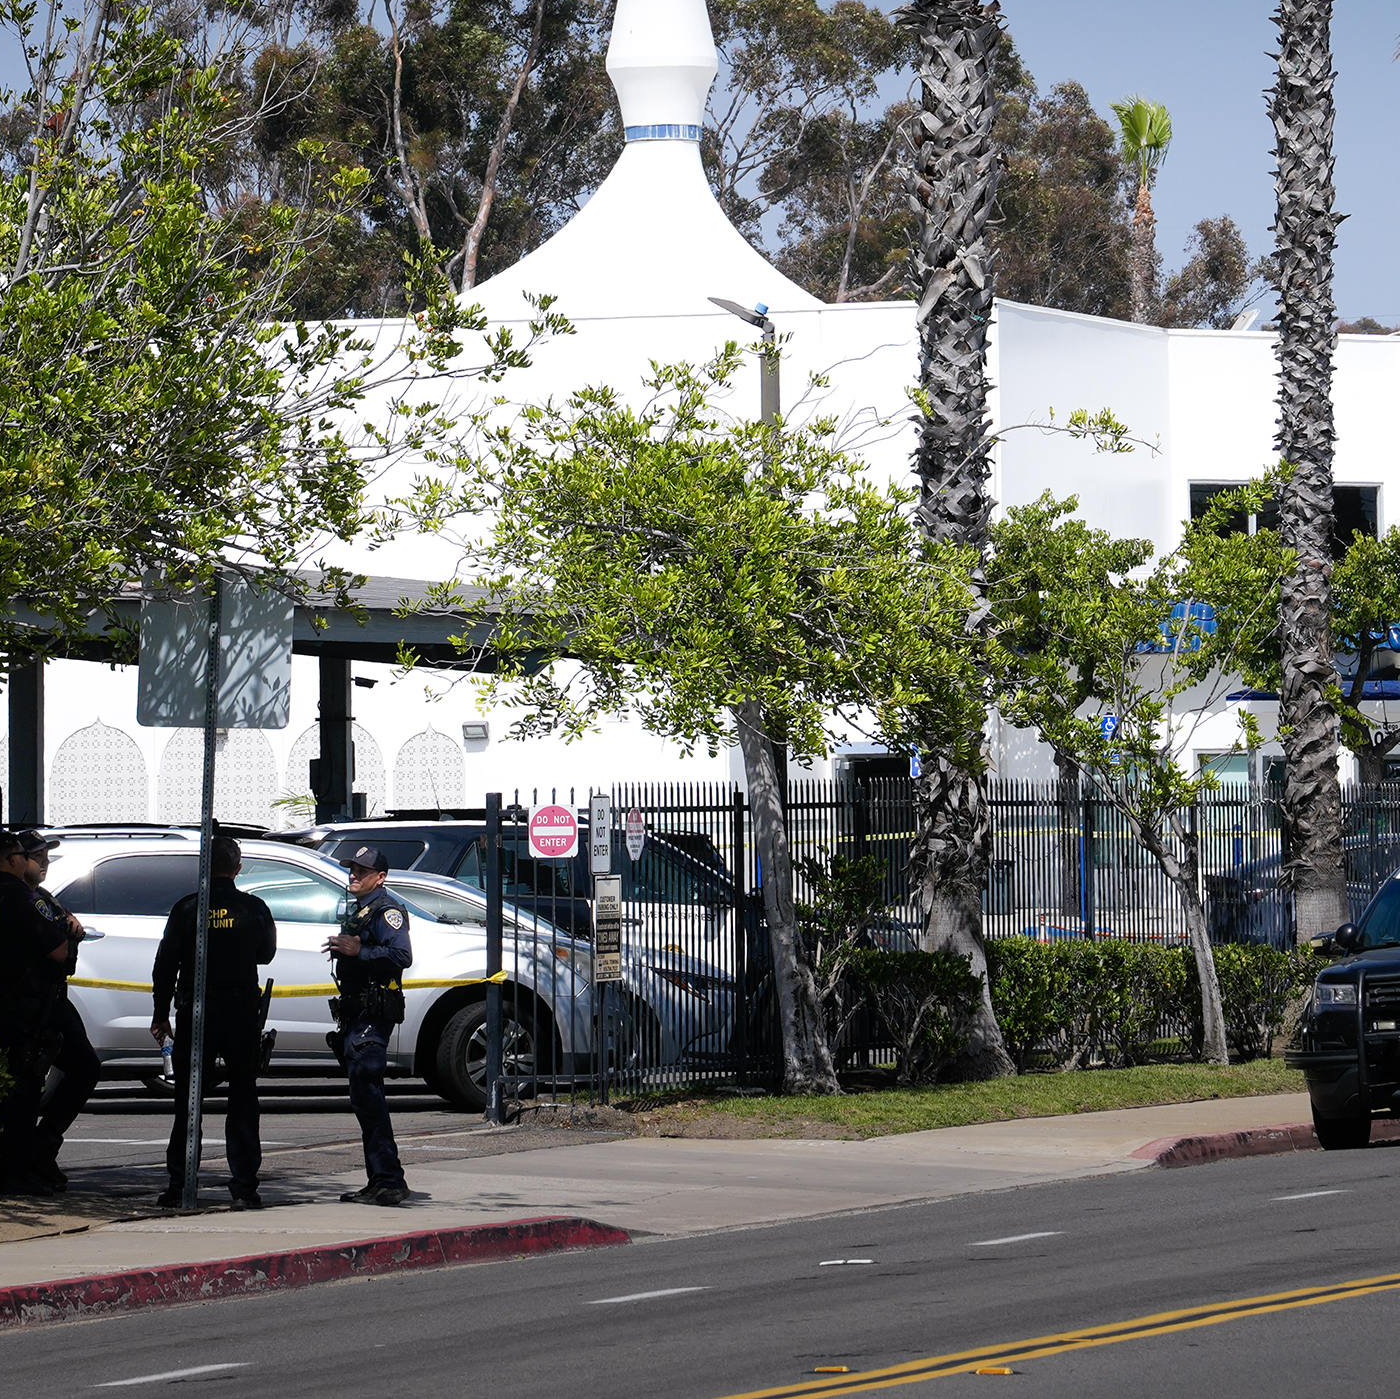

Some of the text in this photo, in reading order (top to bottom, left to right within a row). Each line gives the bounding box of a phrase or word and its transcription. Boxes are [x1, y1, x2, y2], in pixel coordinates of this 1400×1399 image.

[597, 809, 605, 820] DO
[536, 816, 570, 824] DO NOT
[596, 826, 606, 838] NOT
[540, 838, 568, 847] ENTER
[594, 845, 608, 856] ENTER
[213, 918, 234, 928] UNIT
